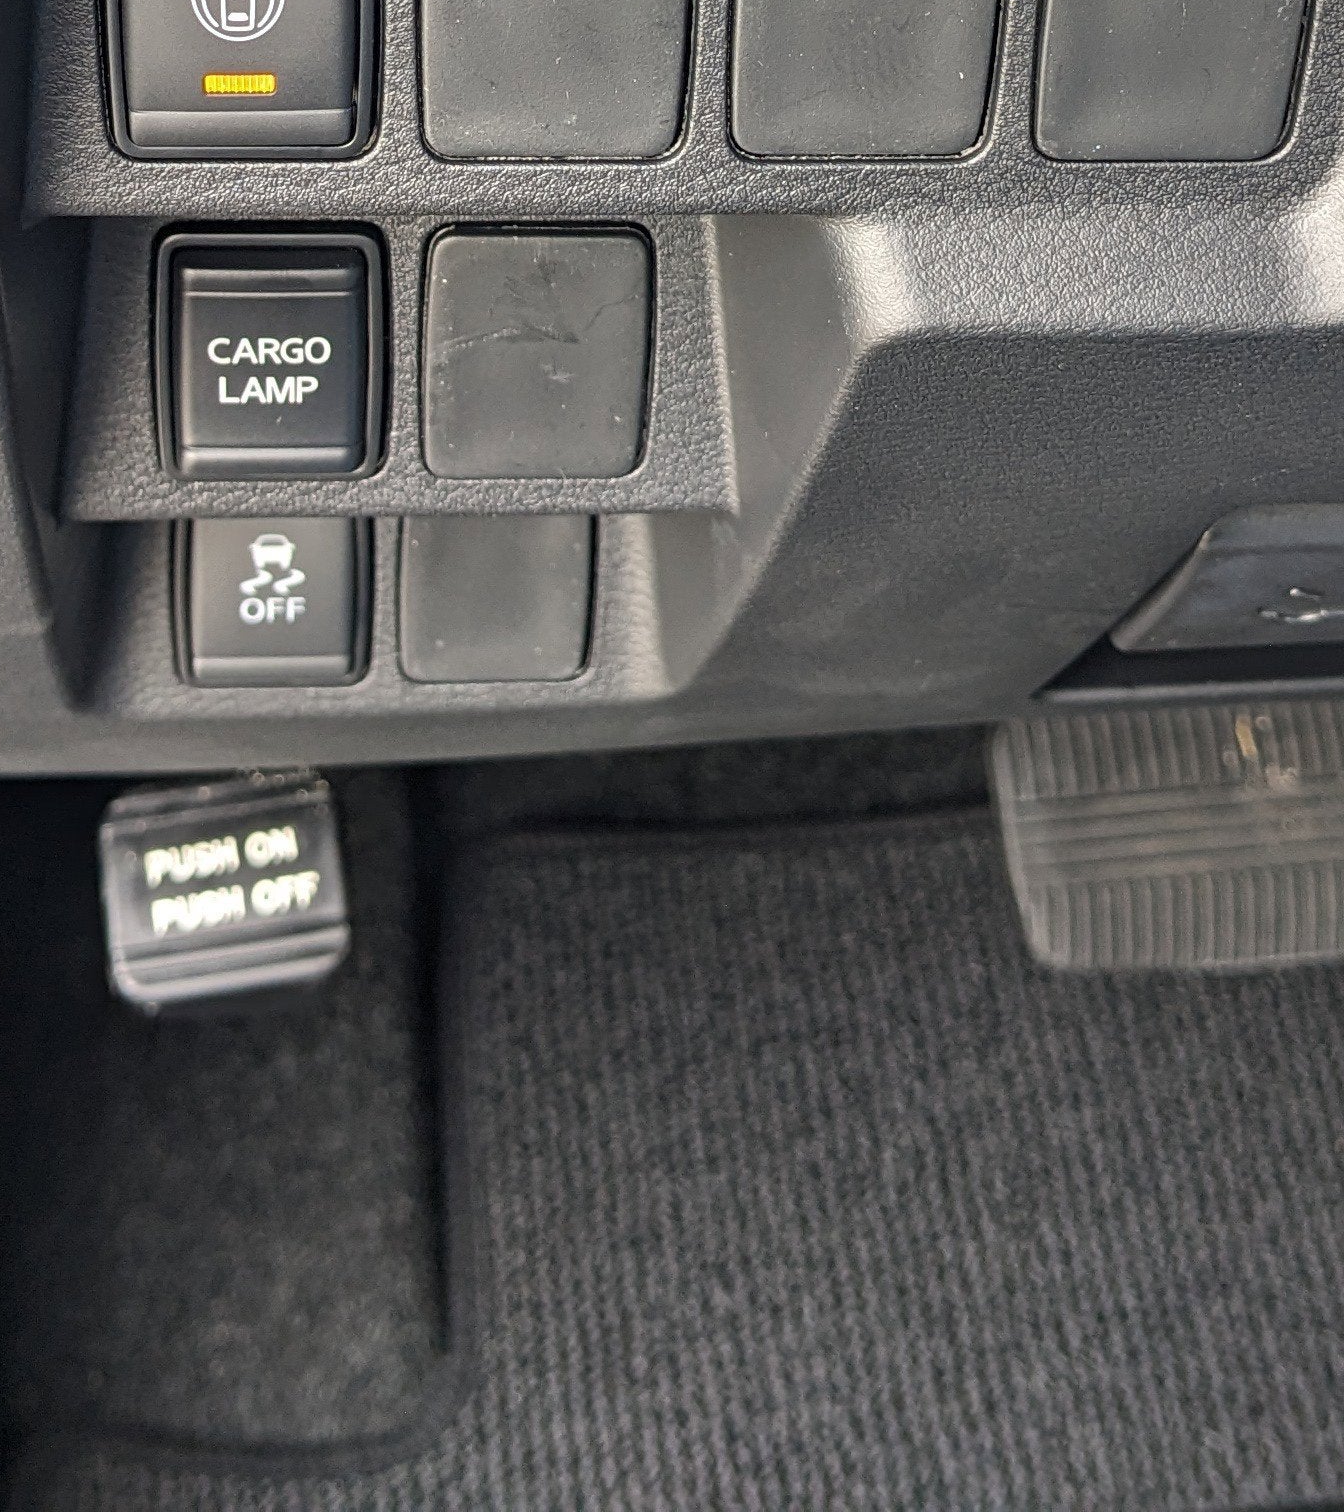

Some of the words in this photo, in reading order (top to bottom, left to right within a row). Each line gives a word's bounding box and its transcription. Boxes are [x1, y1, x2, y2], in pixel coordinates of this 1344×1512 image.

[206, 335, 332, 366] CARGO
[217, 375, 319, 407] LAMP
[238, 595, 307, 624] OFF
[143, 835, 241, 888] PUSH
[244, 825, 299, 869] ON
[150, 884, 246, 938] PUSH
[250, 870, 321, 917] OFF
